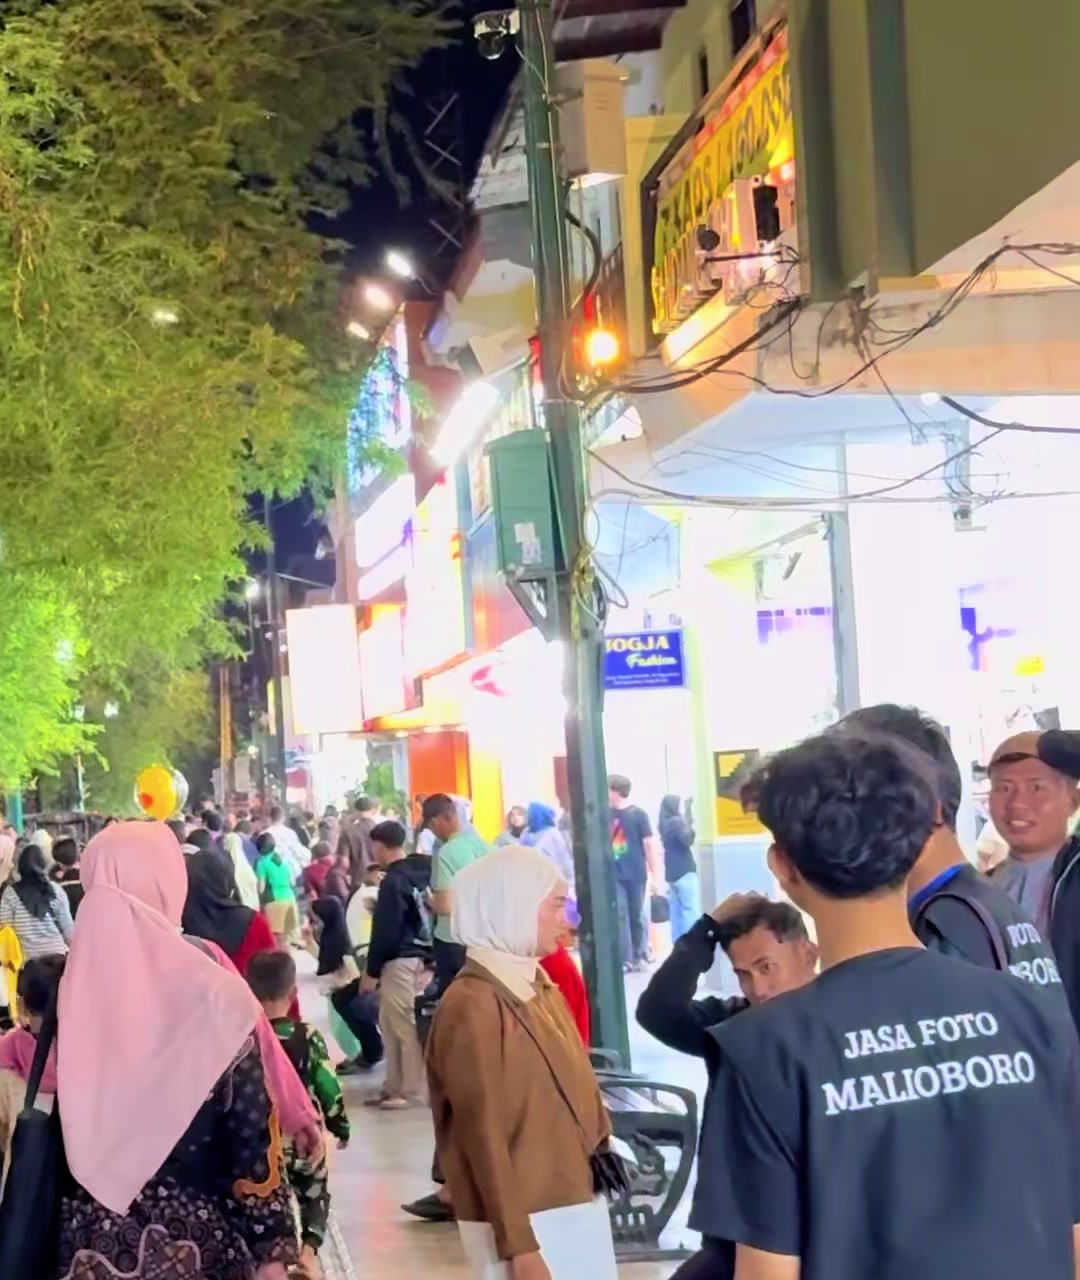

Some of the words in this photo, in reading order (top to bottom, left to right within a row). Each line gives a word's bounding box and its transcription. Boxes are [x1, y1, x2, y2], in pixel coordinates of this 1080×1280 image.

[843, 1023, 916, 1059] JASA
[917, 1011, 999, 1047] FOTO
[821, 1050, 1036, 1116] MALIOBORO
